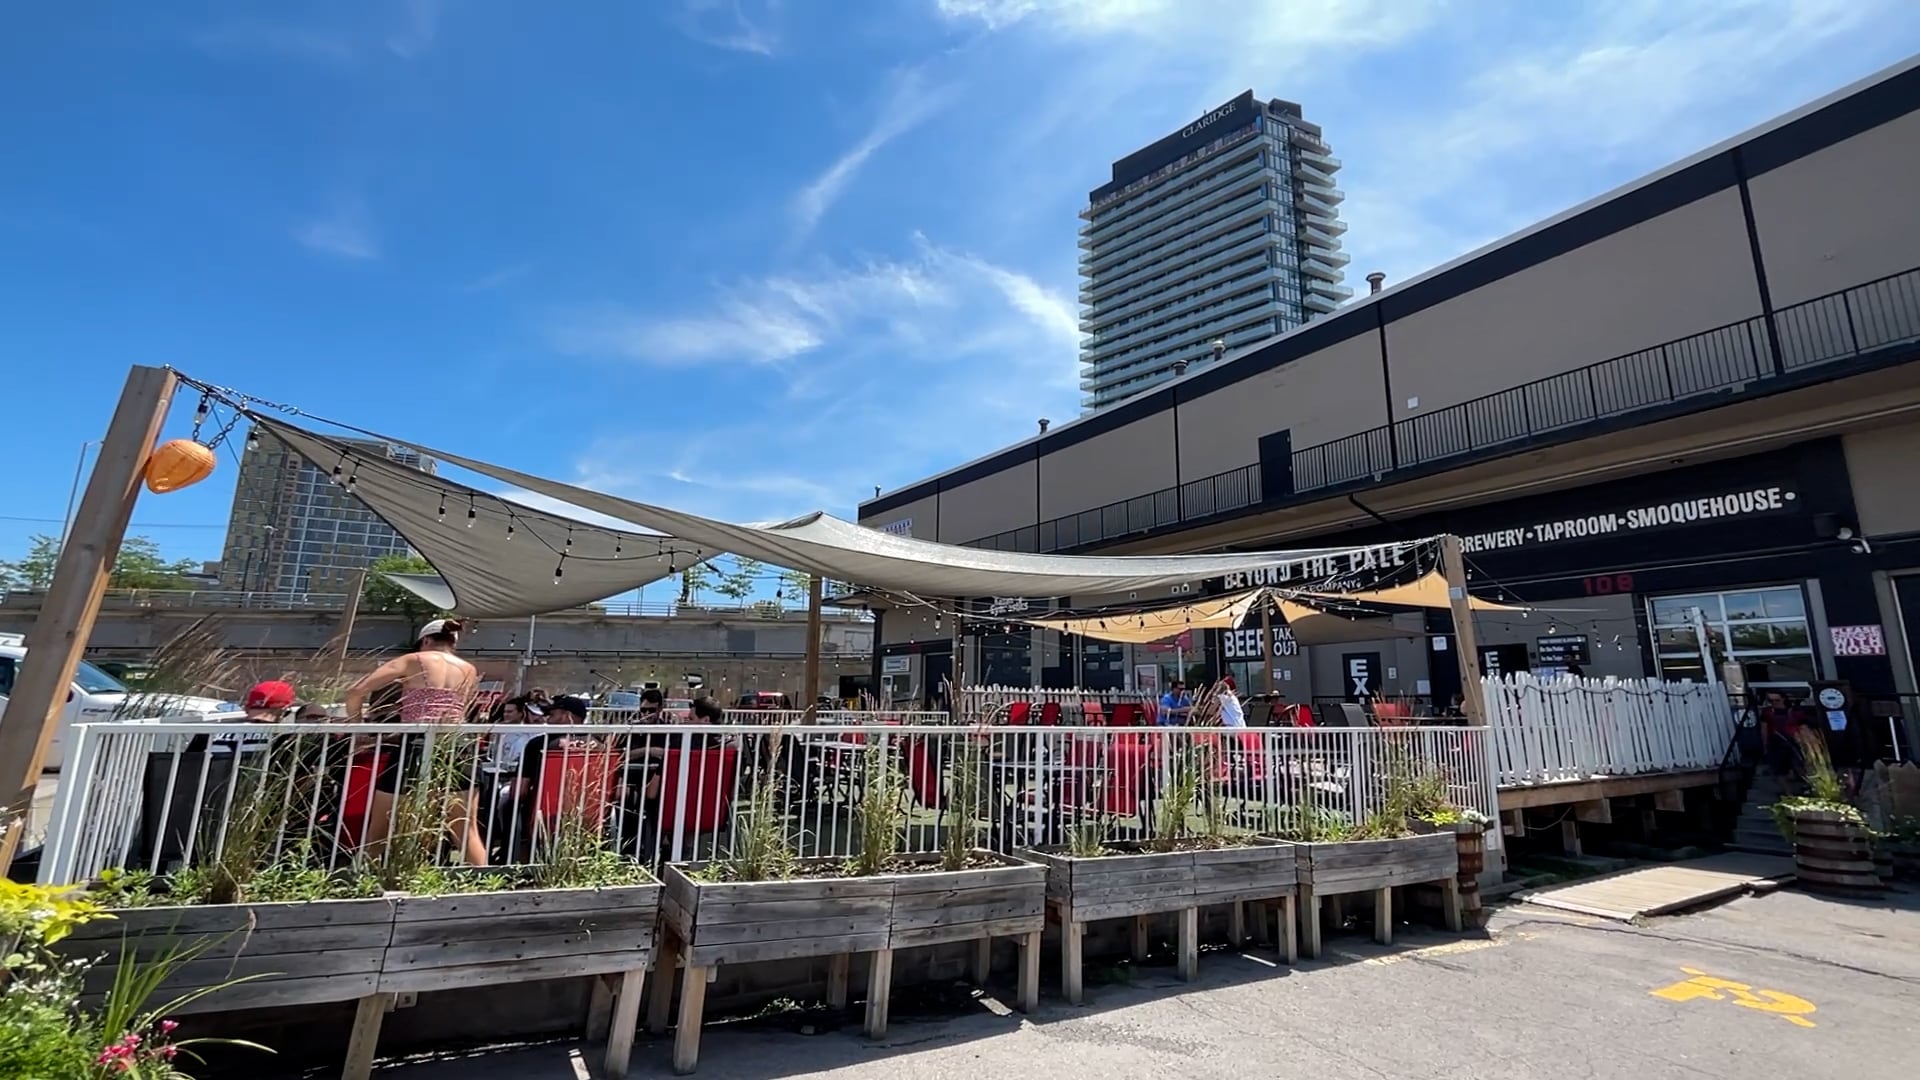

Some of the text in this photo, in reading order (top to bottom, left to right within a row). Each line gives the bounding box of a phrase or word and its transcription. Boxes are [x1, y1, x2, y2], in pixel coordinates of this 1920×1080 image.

[1182, 102, 1237, 138] CLARIDGE
[1224, 545, 1405, 590] BEYOND THE PALE
[1272, 627, 1296, 641] TAK
[1273, 640, 1298, 656] OUT
[1835, 646, 1884, 655] HOST
